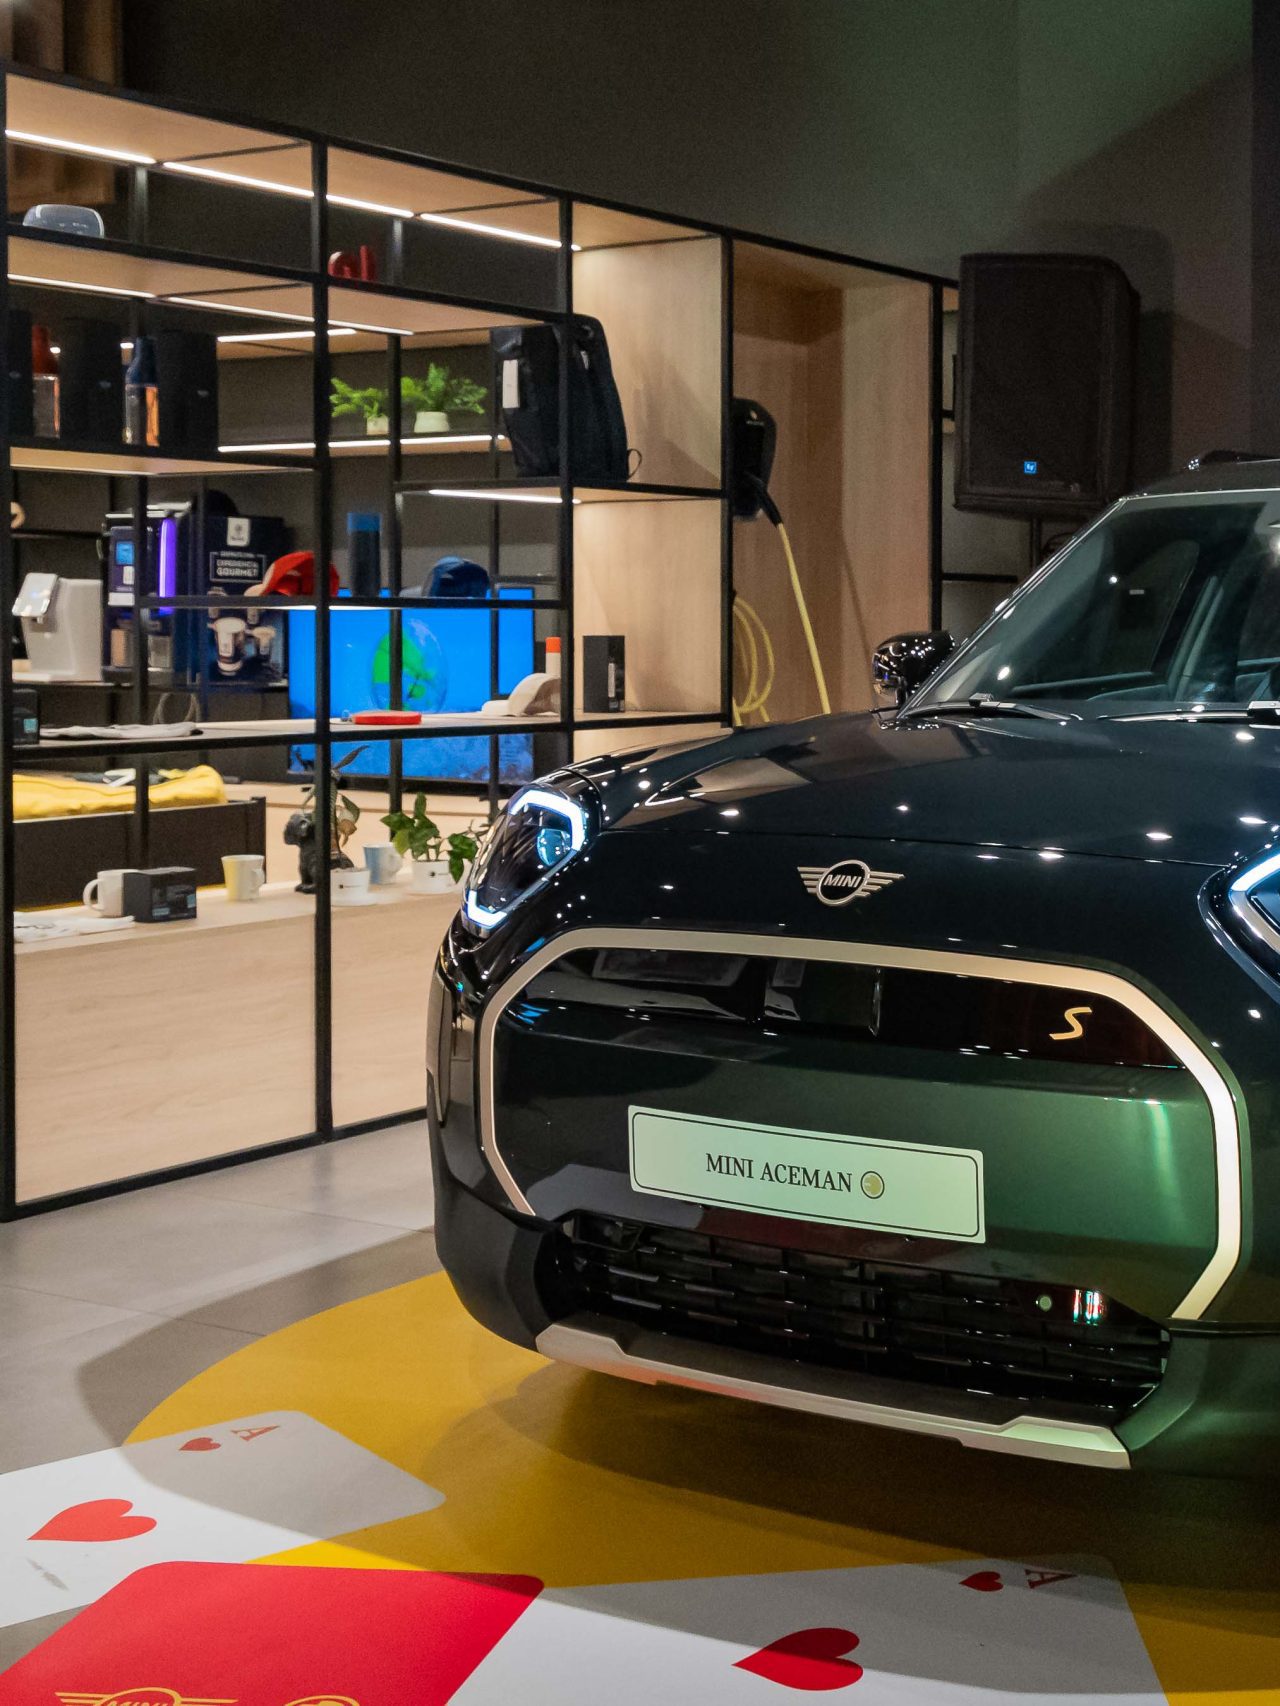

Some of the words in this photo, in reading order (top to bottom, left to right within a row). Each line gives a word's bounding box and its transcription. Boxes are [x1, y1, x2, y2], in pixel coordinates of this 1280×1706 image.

[216, 567, 258, 577] GOURMET
[823, 874, 862, 888] MINI
[1049, 1006, 1093, 1041] S
[705, 1152, 754, 1179] MINI
[760, 1161, 853, 1193] ACEMAN
[231, 1425, 279, 1441] A
[1025, 1568, 1077, 1589] A
